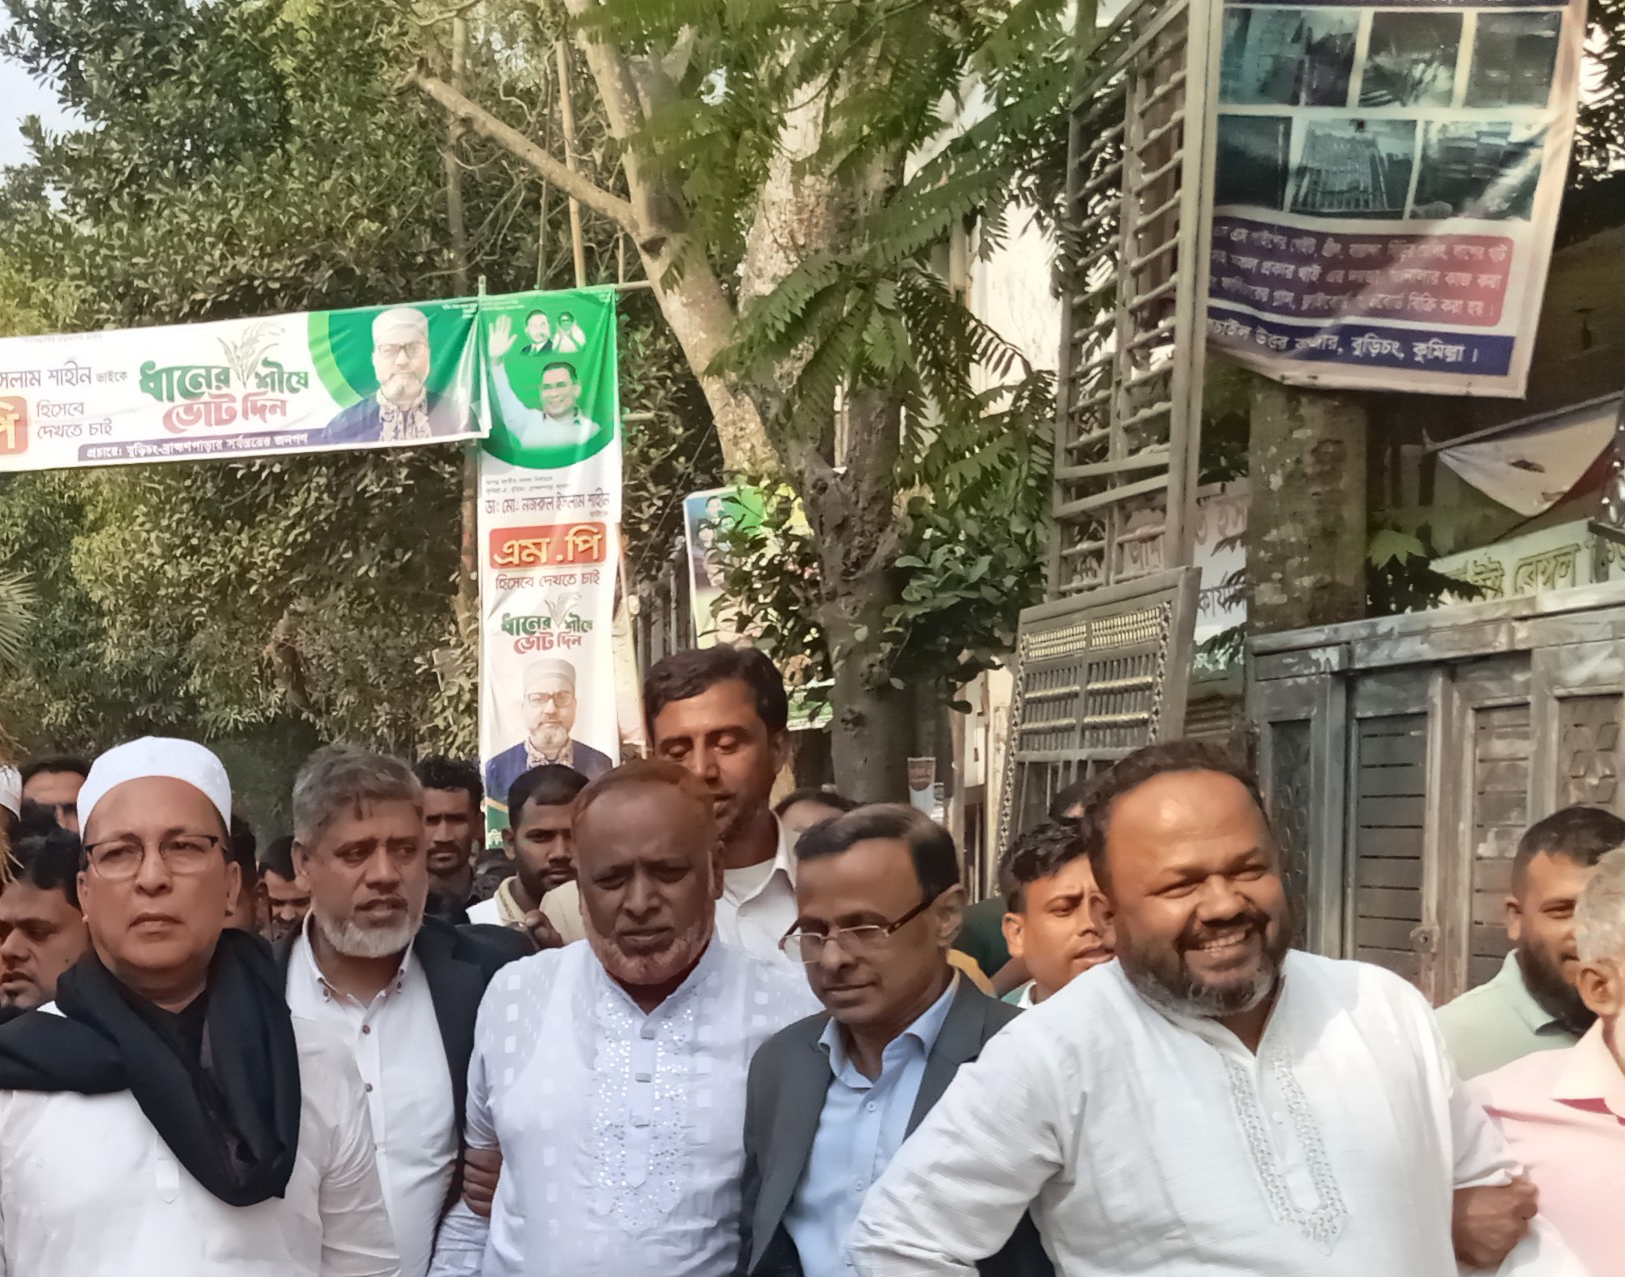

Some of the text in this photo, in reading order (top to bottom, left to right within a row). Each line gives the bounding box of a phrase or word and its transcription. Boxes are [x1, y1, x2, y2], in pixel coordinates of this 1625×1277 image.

[1412, 337, 1465, 363] কুমিল্লা
[47, 358, 92, 388] শাহীন
[96, 370, 128, 384] ভাইকে
[138, 357, 309, 402] ধানের শীষে
[36, 400, 85, 418] হিসেবে
[162, 390, 289, 434] ভোট দিন
[37, 418, 113, 440] দেখতে চাই
[522, 496, 554, 512] নজরুল
[495, 569, 601, 592] হিসেবে দেখতে চাই
[501, 612, 593, 637] ধানের শীষে
[513, 630, 583, 655] ভোট দিন
